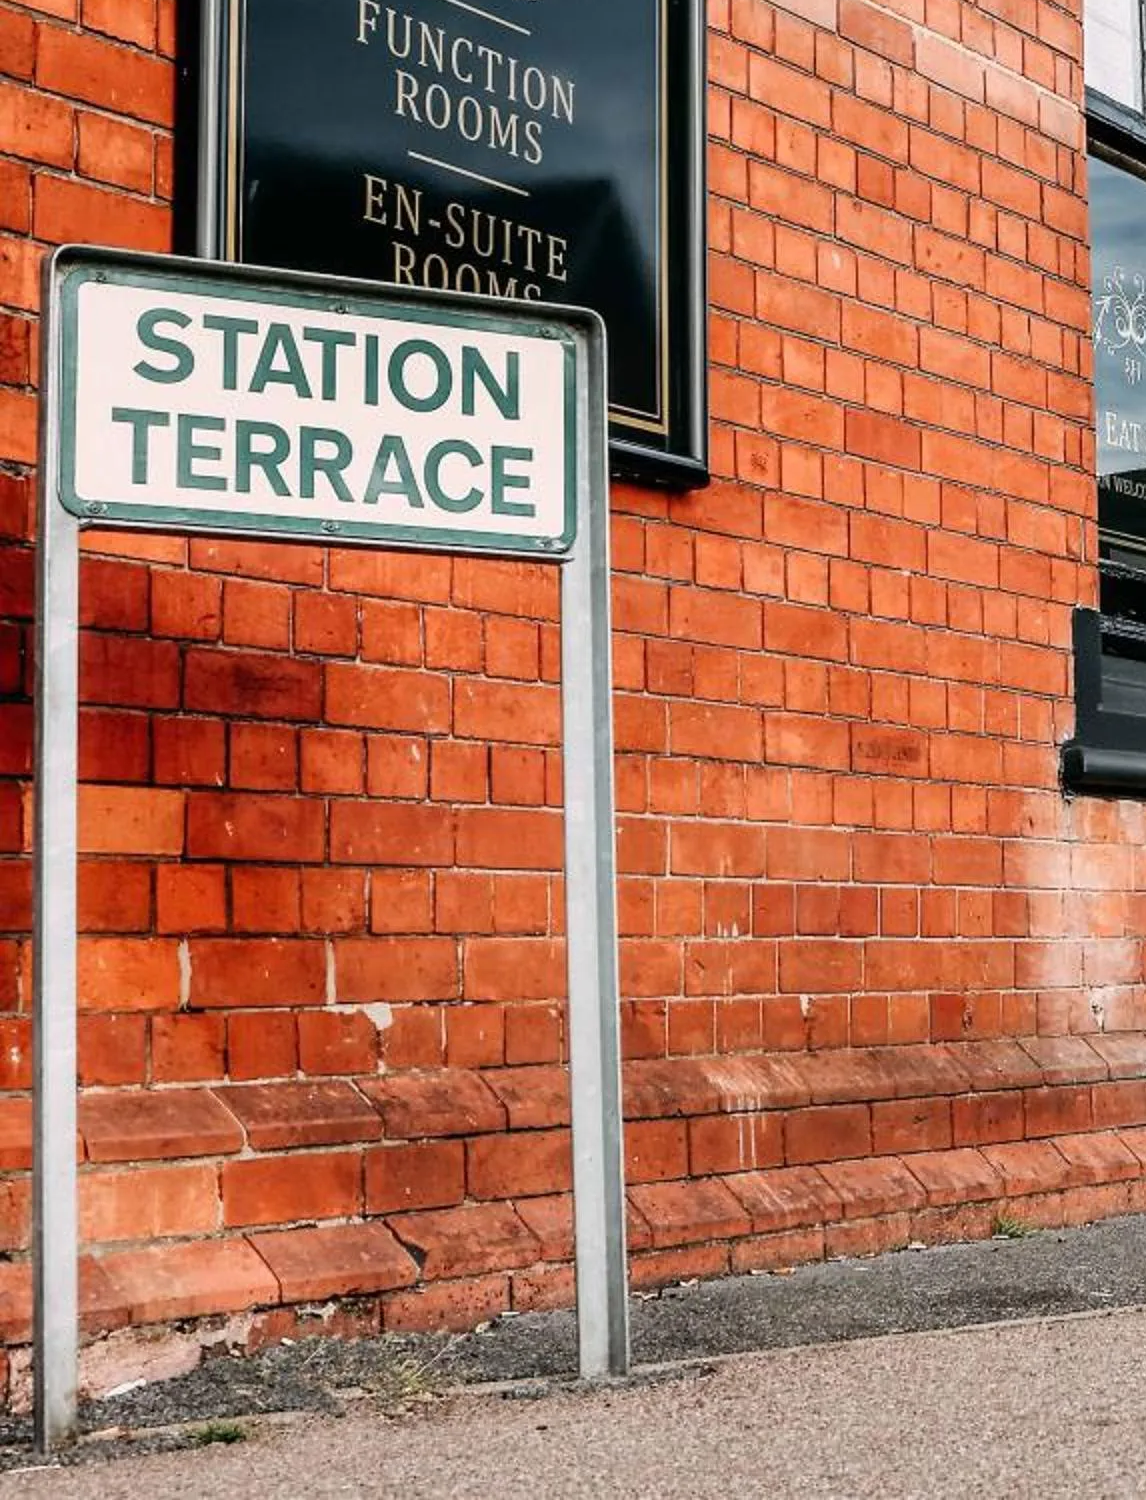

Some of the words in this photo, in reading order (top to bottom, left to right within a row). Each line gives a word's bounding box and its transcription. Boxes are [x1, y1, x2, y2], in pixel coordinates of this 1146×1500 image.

[393, 68, 543, 165] ROOMS
[362, 173, 568, 282] EN-SUITE
[132, 307, 520, 421] STATION
[111, 407, 536, 518] TERRACE
[1105, 411, 1141, 453] EAT
